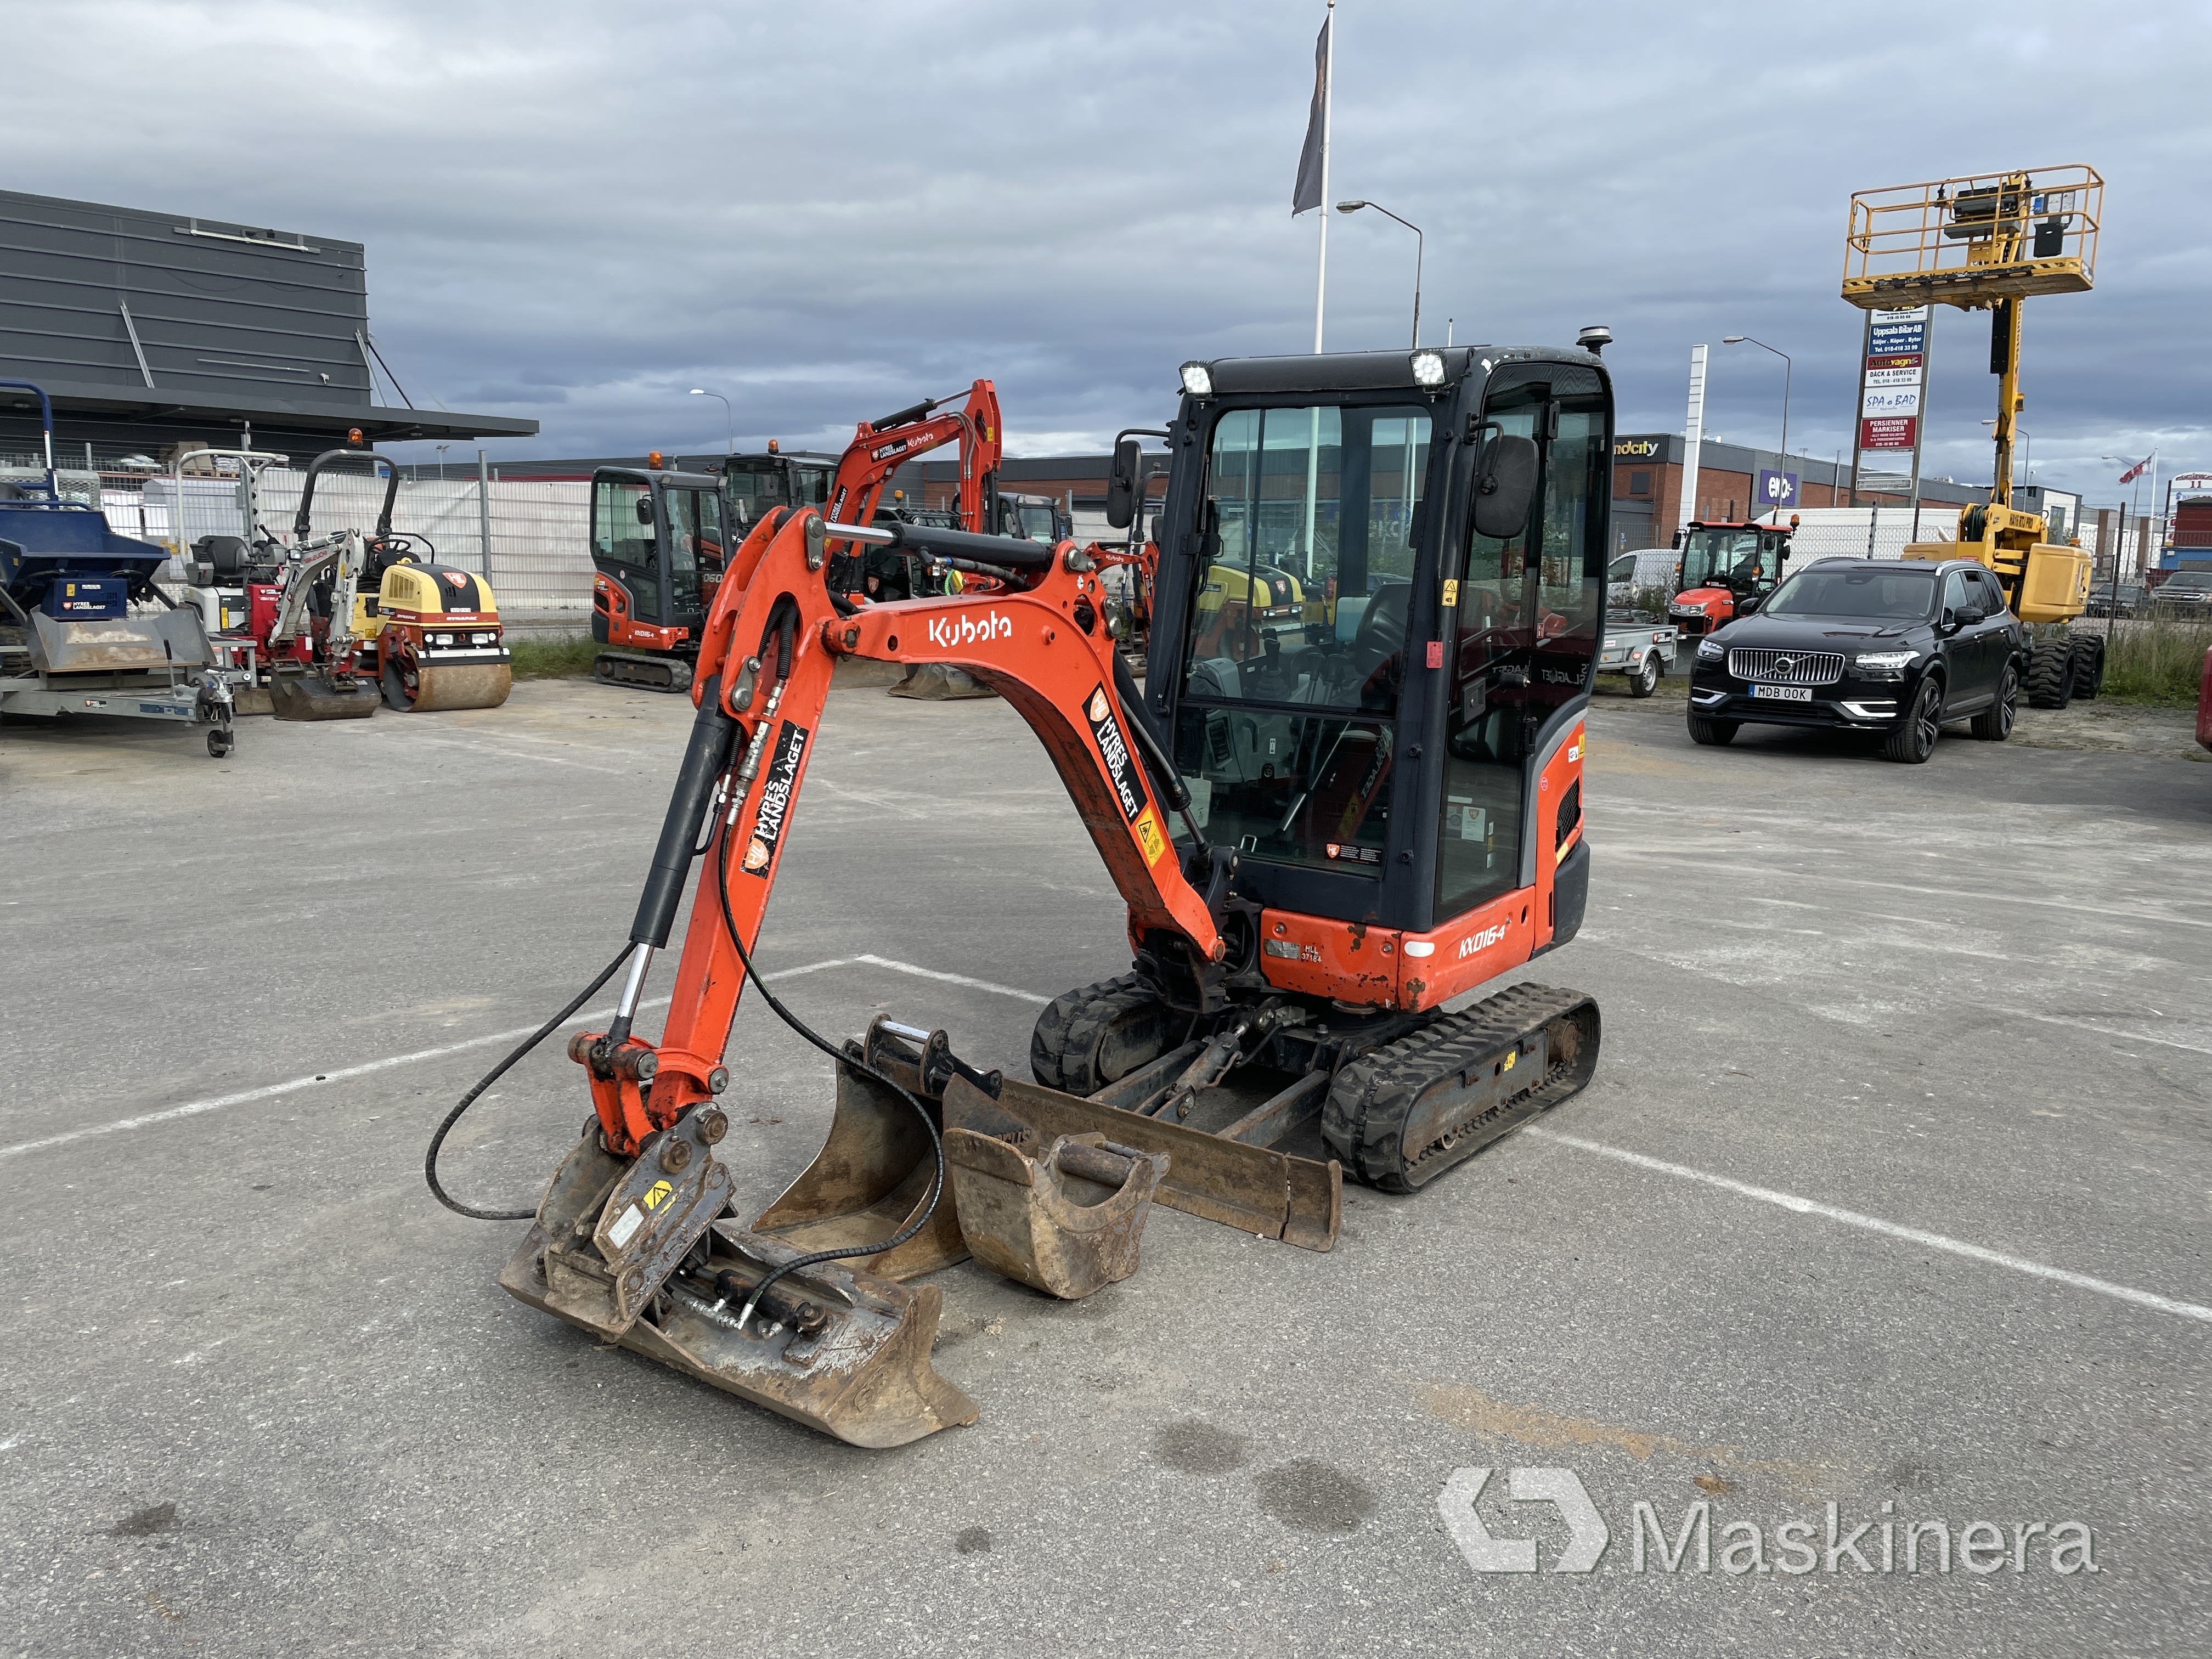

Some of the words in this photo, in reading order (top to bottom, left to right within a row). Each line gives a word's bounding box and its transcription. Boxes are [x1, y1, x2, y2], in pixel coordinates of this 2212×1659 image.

[1873, 326, 1898, 337] Uppsala
[1898, 325, 1913, 334] Bilar
[1913, 325, 1922, 333] AB
[1866, 396, 1884, 407] SPA
[1895, 394, 1916, 405] BAD
[907, 432, 934, 447] Kubota
[879, 444, 893, 453] HYRES
[879, 445, 907, 459] LANDSLAGET
[1613, 441, 1658, 457] ndcity
[703, 573, 723, 583] 060
[929, 610, 1012, 647] Kubota
[1758, 686, 1780, 697] MDB
[1104, 715, 1128, 766] HYRES
[1097, 725, 1138, 819] LANDSLAGET
[765, 729, 804, 841] LANDSLAGET
[755, 780, 779, 837] HYRES
[1458, 924, 1505, 960] KX016-4
[1305, 945, 1318, 955] HLL
[1301, 952, 1322, 963] 37184
